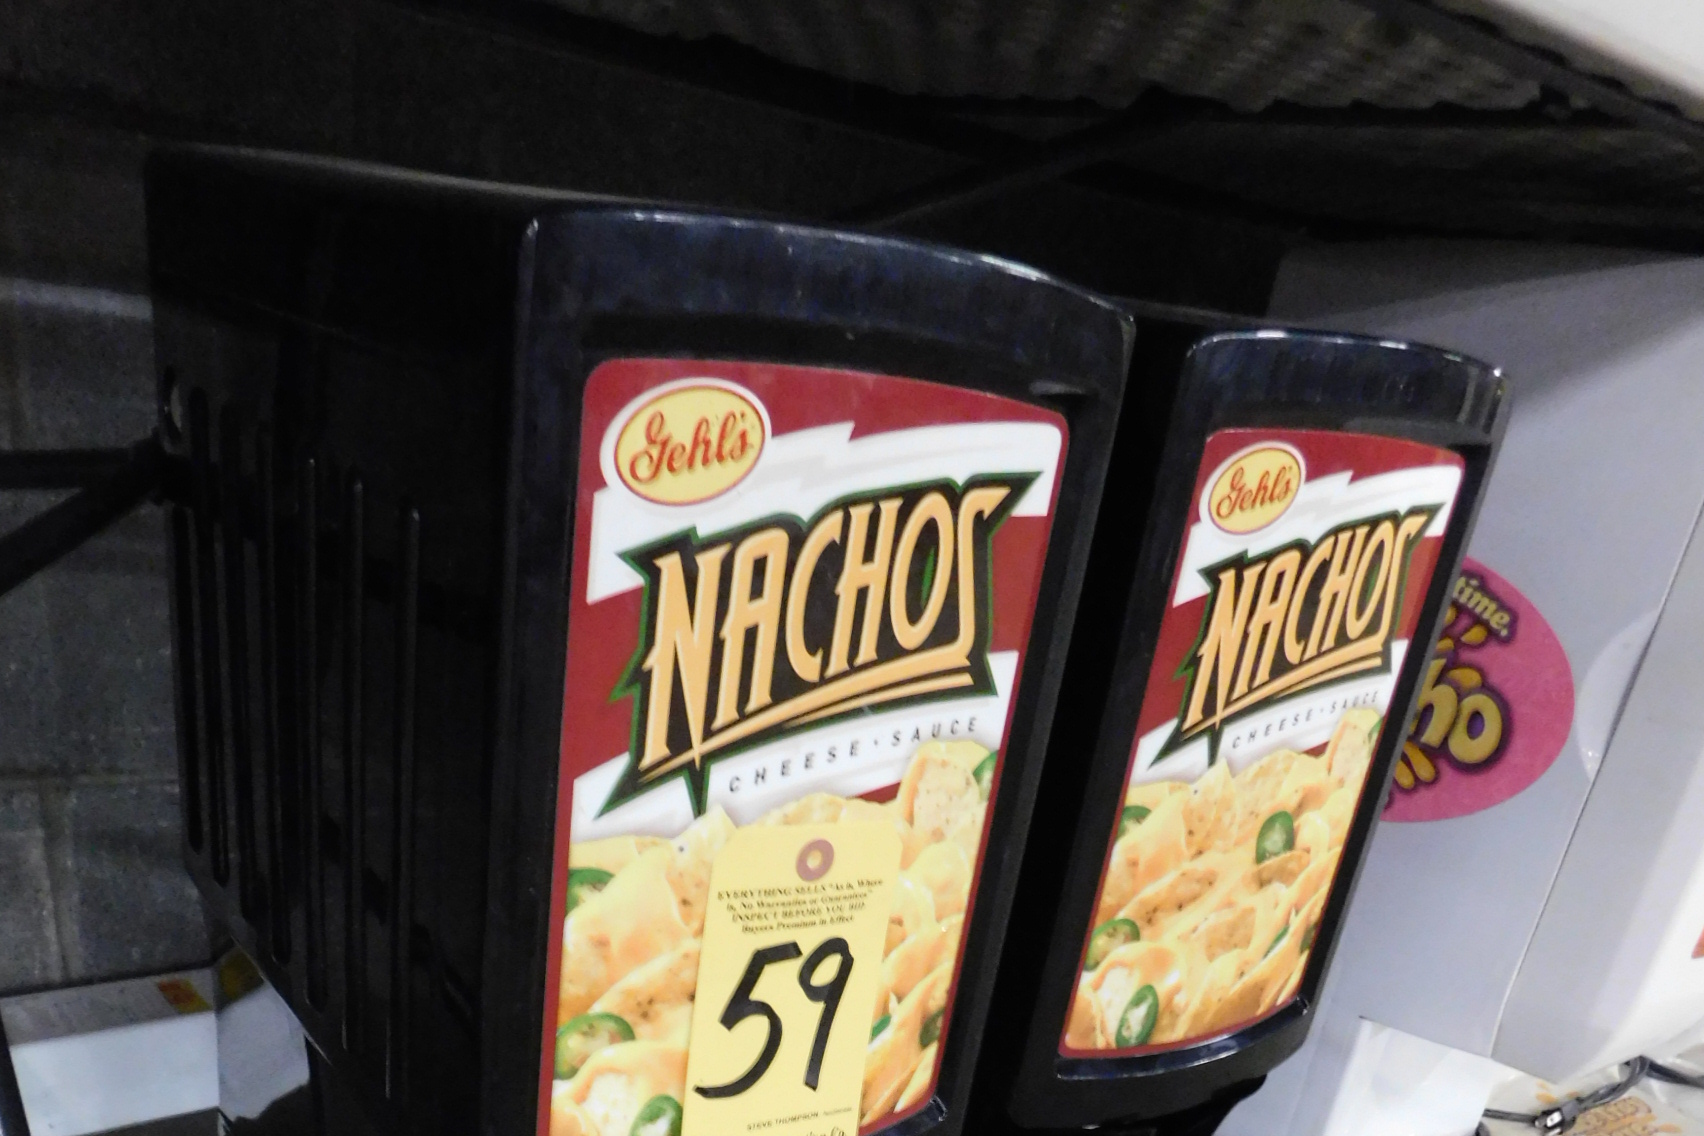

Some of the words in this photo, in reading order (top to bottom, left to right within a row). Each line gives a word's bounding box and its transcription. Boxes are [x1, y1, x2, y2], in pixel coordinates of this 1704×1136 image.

[629, 409, 750, 484] Gehl's
[1216, 465, 1293, 519] Gehl's
[639, 485, 1012, 769] NACHOS
[1182, 512, 1428, 731] NACHOS
[729, 741, 860, 793] CHEESE
[891, 717, 977, 747] SAUCE
[1232, 708, 1313, 749] CHEESE
[717, 888, 792, 901] EVERYTHING
[794, 884, 826, 895] SELLS
[857, 879, 883, 888] Where
[732, 911, 777, 922] INSPECT
[782, 907, 822, 918] BEFORE
[826, 904, 843, 914] YOU
[777, 920, 816, 930] Premium
[693, 936, 854, 1099] 59
[747, 1120, 772, 1131] STEVE
